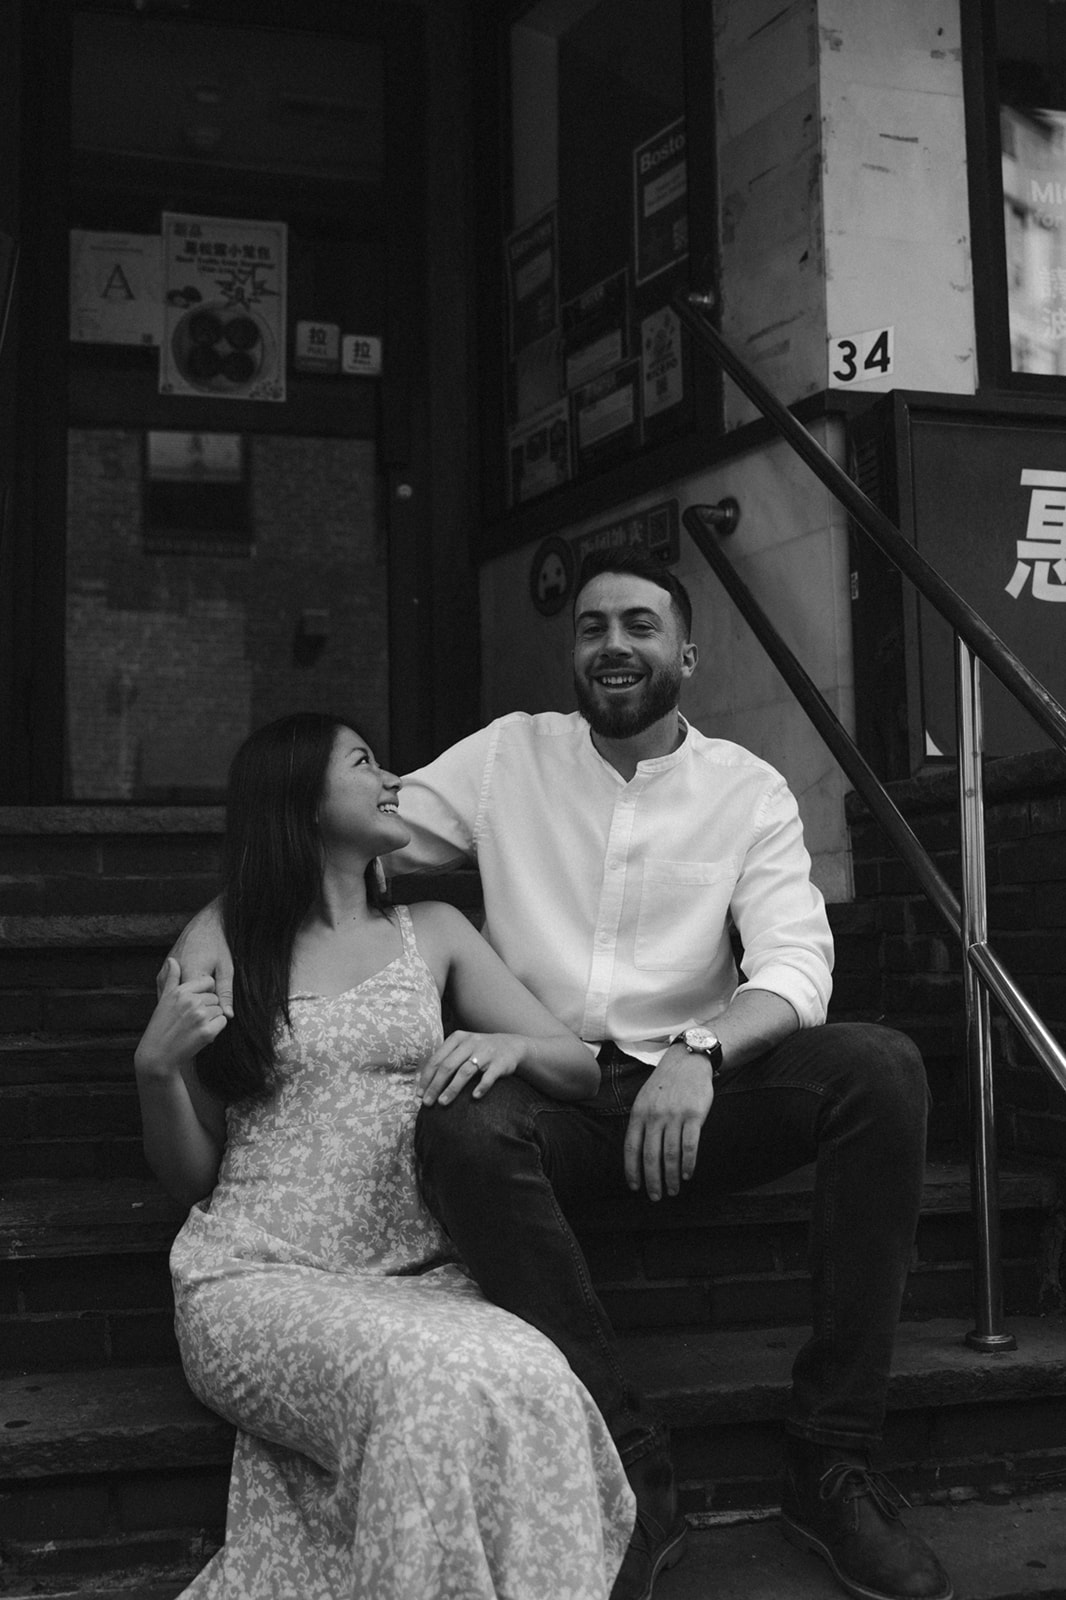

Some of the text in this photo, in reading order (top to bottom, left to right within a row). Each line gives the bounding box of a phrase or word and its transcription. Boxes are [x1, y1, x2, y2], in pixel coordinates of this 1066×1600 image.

[1030, 179, 1066, 205] MI
[100, 264, 136, 300] A
[833, 330, 890, 381] 34
